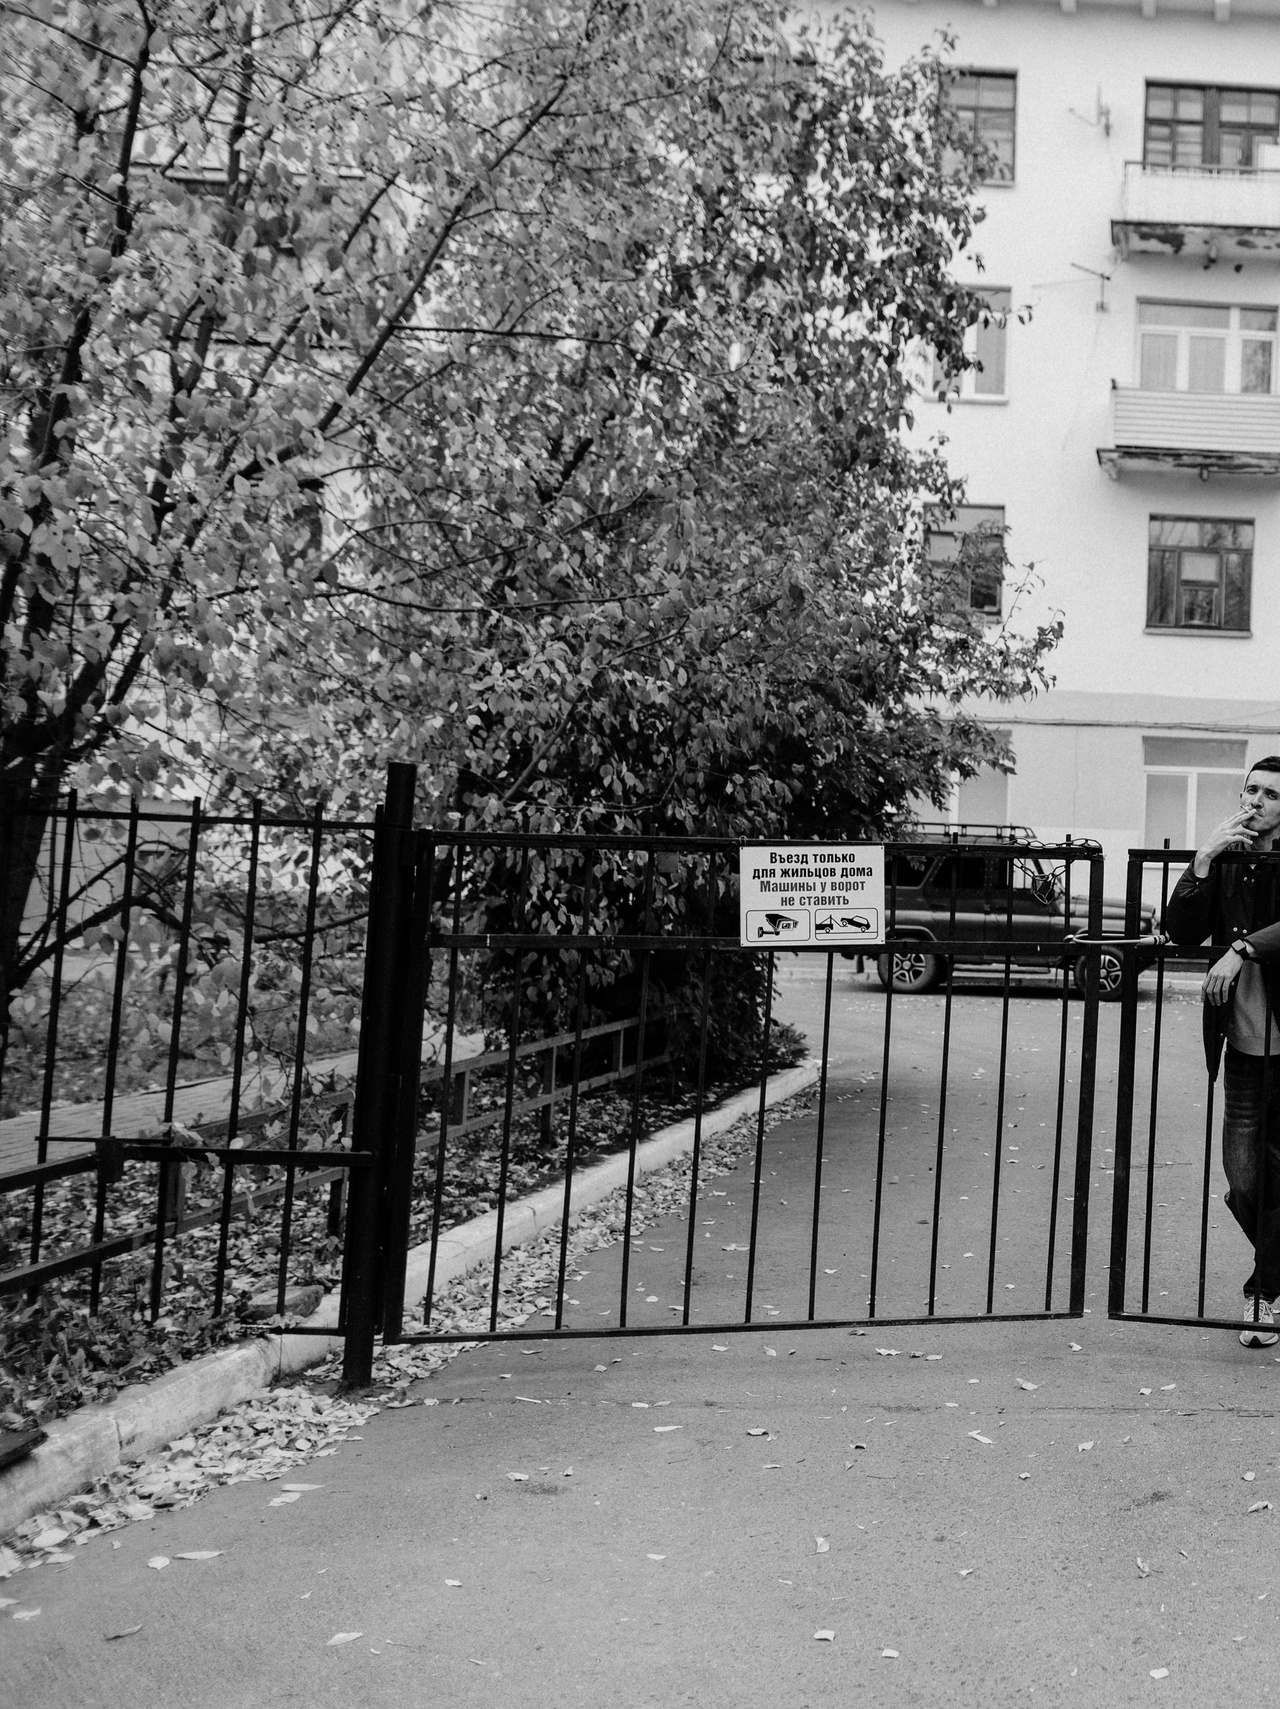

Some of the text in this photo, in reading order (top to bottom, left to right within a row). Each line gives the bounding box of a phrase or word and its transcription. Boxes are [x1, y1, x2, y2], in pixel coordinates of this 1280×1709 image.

[770, 852, 855, 865] Въезд только
[752, 866, 873, 879] для жильцов дома
[760, 880, 866, 893] Машины у ворот
[781, 895, 849, 906] не ставить
